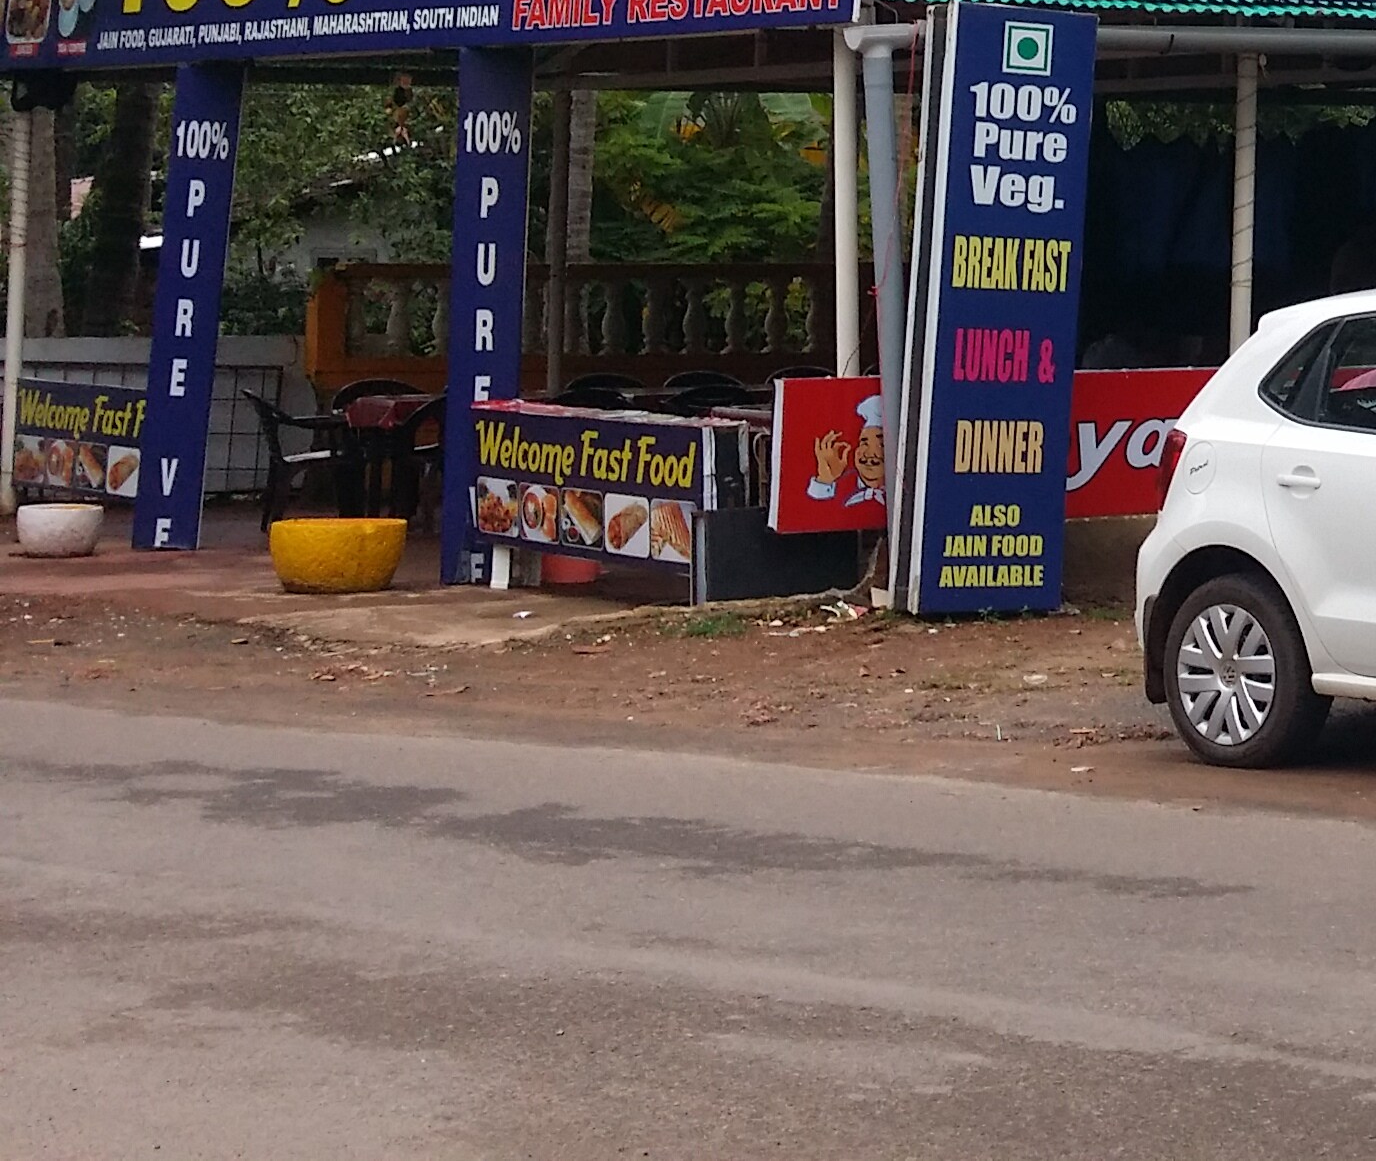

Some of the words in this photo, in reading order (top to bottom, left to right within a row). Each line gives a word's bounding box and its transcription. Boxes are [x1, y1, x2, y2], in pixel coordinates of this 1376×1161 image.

[97, 30, 118, 50] JAIN
[148, 26, 196, 47] GUJARATI,
[198, 21, 242, 46] PUNJABI,
[244, 17, 311, 43] RAJASTHANI,
[313, 10, 410, 37] MAHARASHTRIAN,
[413, 7, 455, 30] SOUTH
[456, 4, 500, 28] INDIAN
[970, 82, 1077, 124] 100%
[176, 119, 229, 160] 100%
[463, 110, 522, 154] 100%
[973, 121, 1067, 163] Pure
[970, 164, 1065, 213] Veg.
[952, 234, 1020, 290] BREAK
[1021, 239, 1072, 293] FAST
[953, 328, 1030, 383] LUNCH
[1037, 339, 1056, 383] &
[18, 388, 91, 440] Welcome
[92, 395, 132, 437] Fast
[475, 420, 575, 485] Welcome
[580, 430, 633, 484] Fast
[637, 436, 697, 488] Food
[954, 419, 1044, 473] DINNER
[970, 504, 1021, 527] ALSO
[943, 535, 987, 557] JAIN
[991, 535, 1044, 557] FOOD
[939, 565, 1044, 588] AVAILABLE
